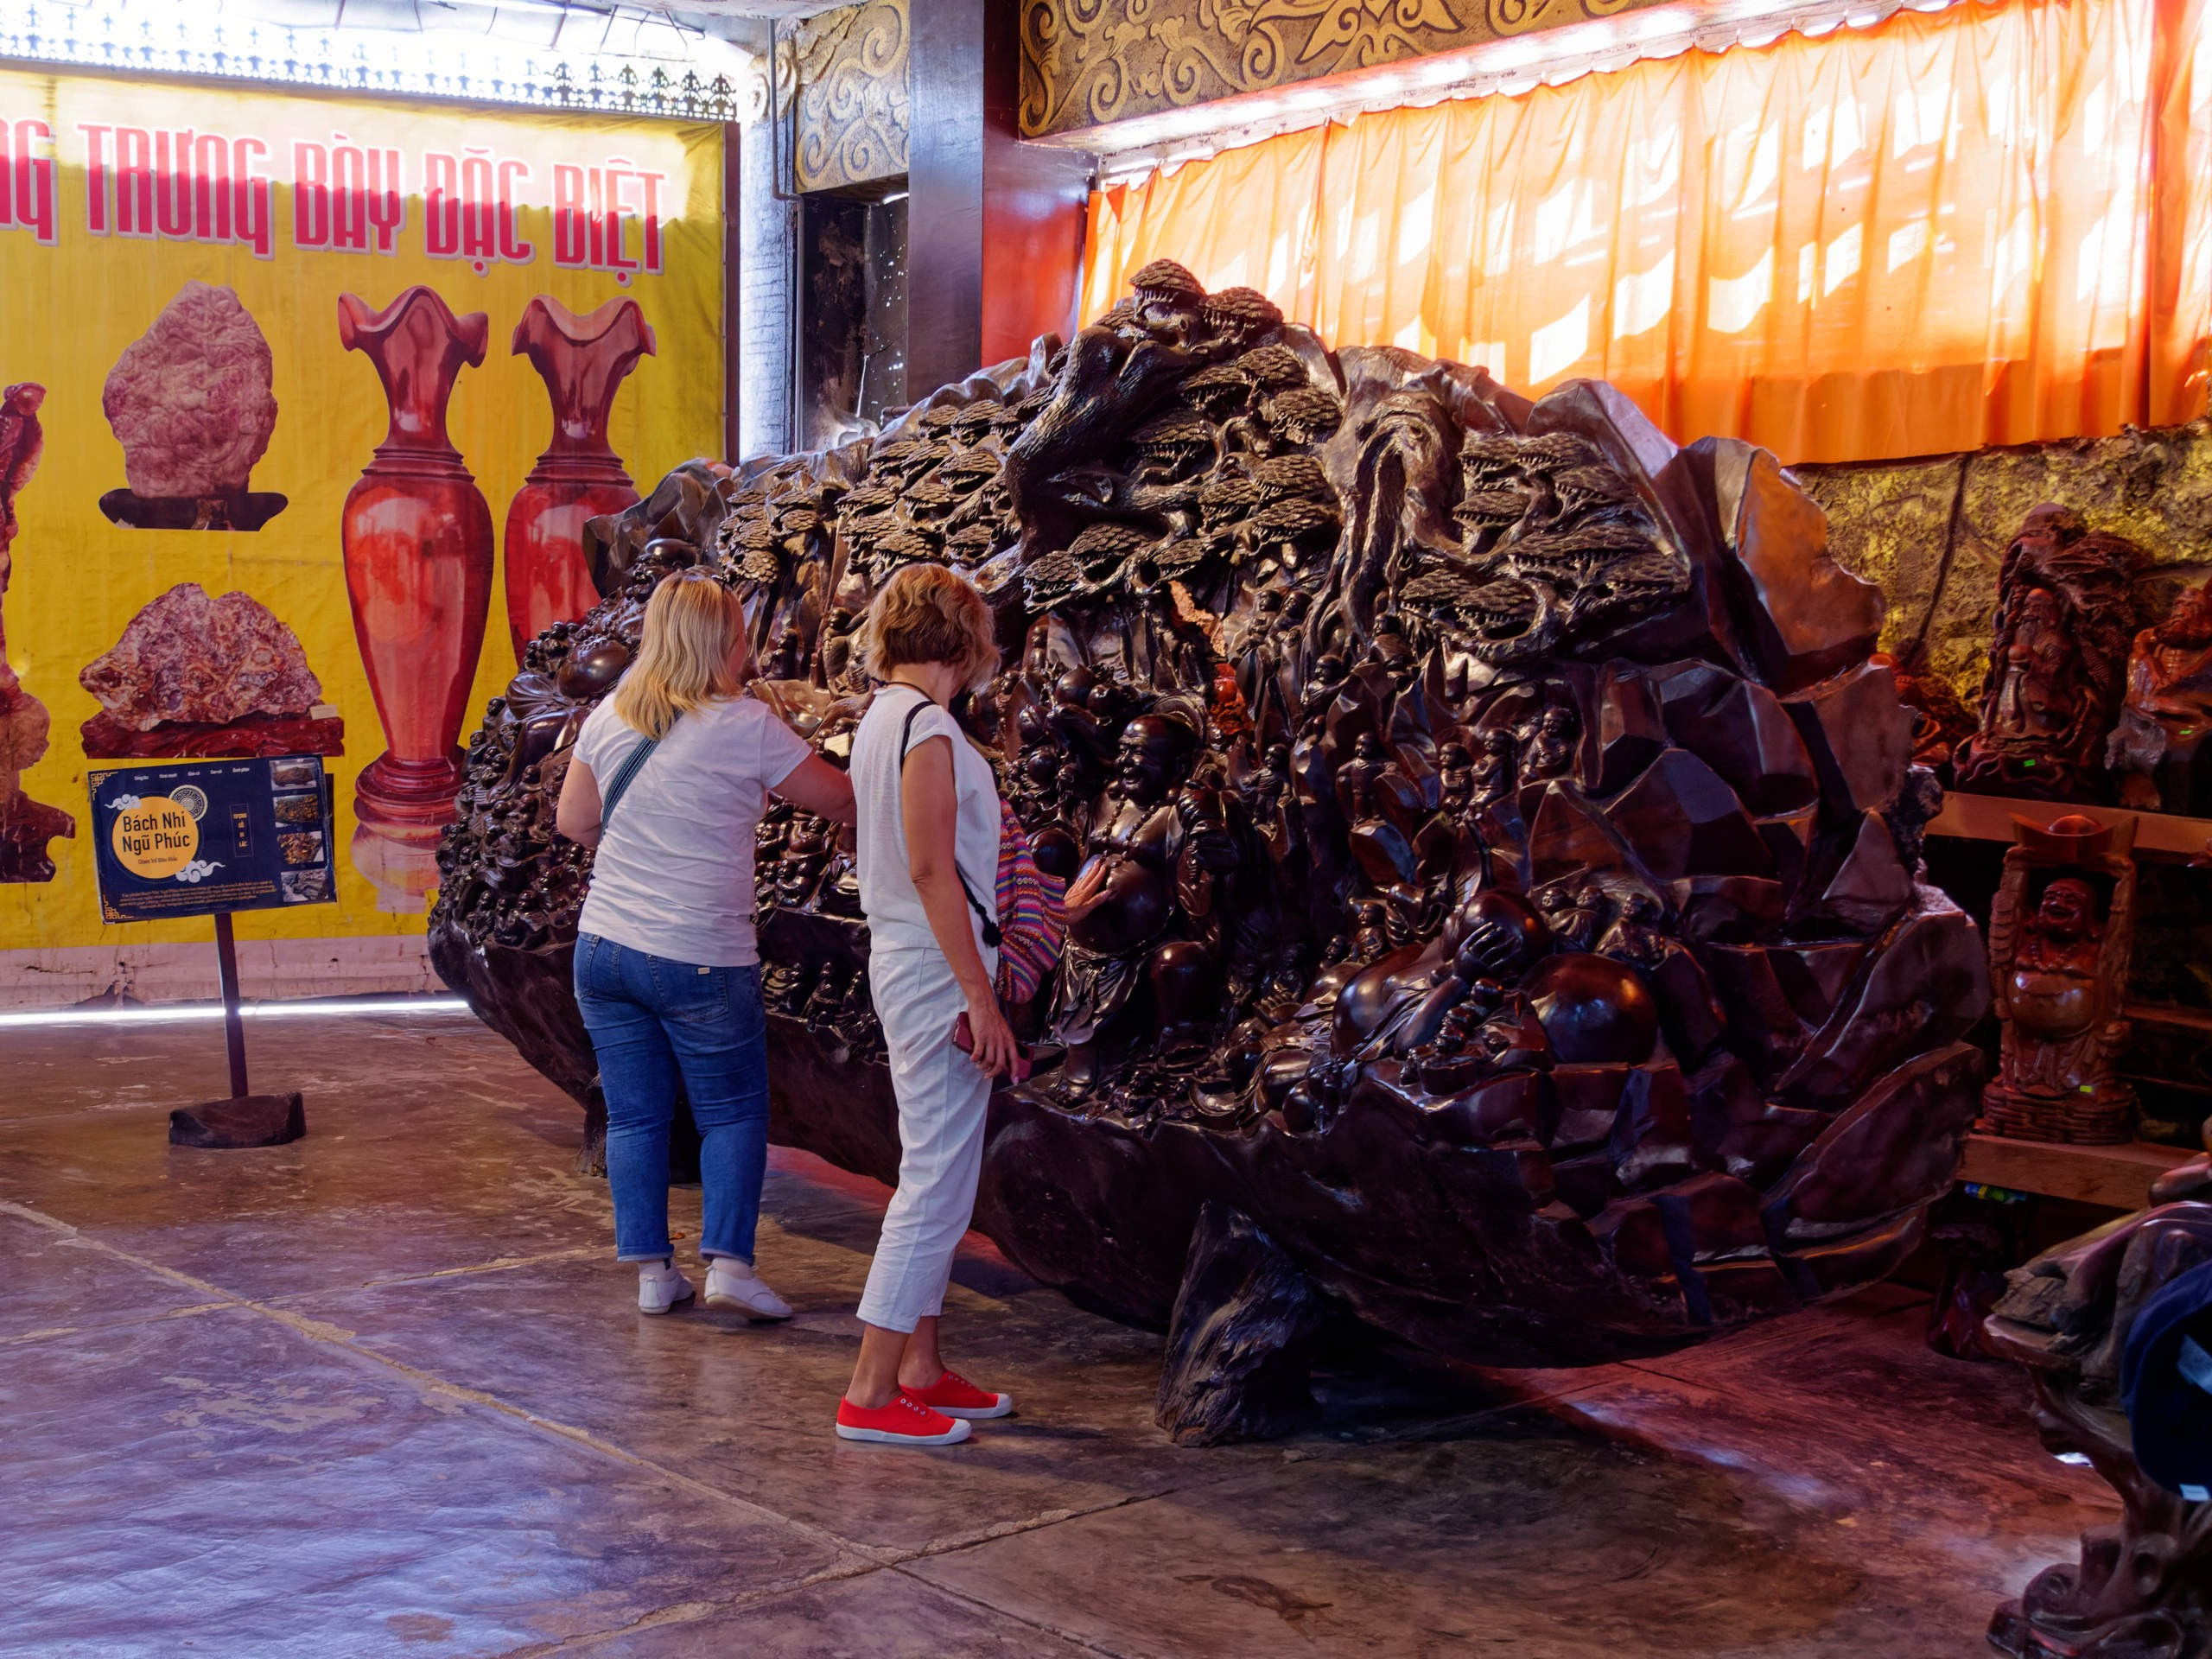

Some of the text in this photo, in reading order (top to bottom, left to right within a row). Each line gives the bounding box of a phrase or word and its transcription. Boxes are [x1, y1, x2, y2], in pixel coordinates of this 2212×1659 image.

[77, 123, 270, 255] TRƯNG
[294, 132, 401, 251] BÀY
[423, 146, 531, 271] ĐẶC
[553, 157, 664, 283] BIỆT
[123, 810, 186, 832] Bách Nhi
[122, 830, 191, 855] Ngũ Phúc
